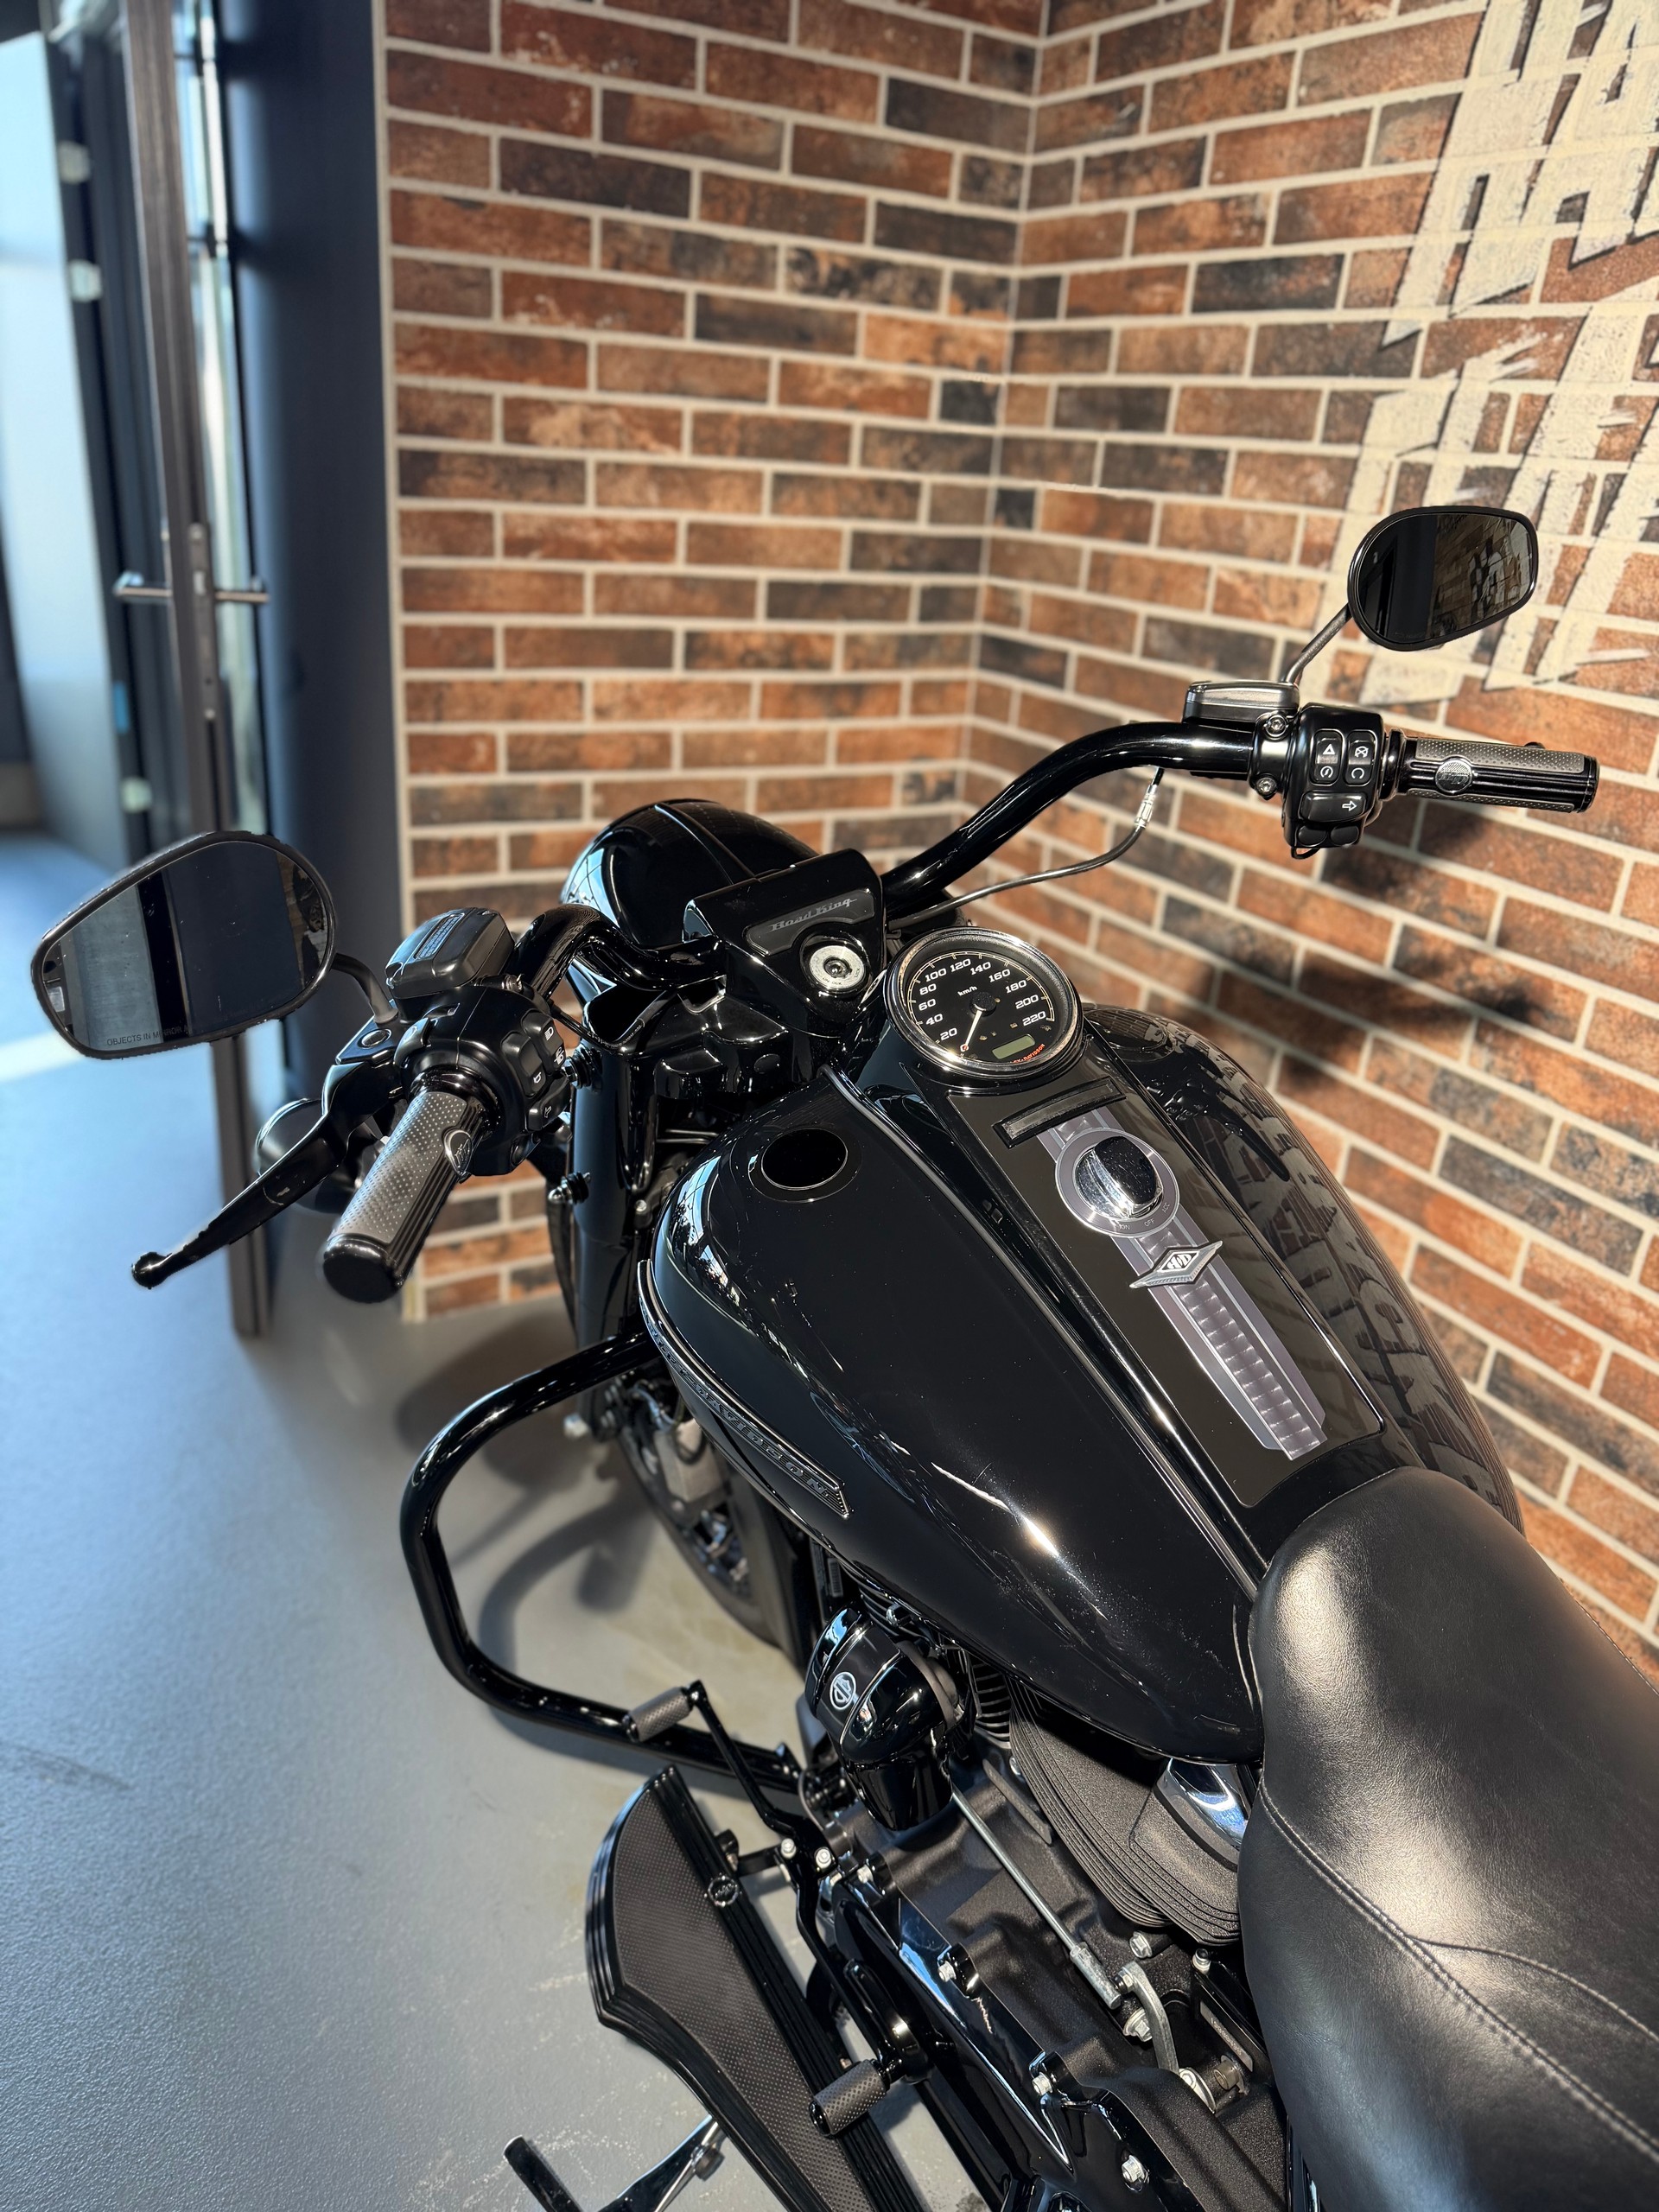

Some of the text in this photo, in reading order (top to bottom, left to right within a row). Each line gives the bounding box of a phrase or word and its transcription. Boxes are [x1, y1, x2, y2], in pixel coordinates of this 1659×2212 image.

[770, 913, 813, 932] Road
[950, 958, 971, 973] 120
[969, 961, 992, 976] 140
[925, 968, 947, 982] 100
[988, 969, 1011, 982] 160
[919, 983, 938, 995] 80
[957, 985, 978, 996] km/h
[1005, 979, 1027, 994] 180
[918, 998, 937, 1011] 60
[1015, 995, 1039, 1009] 200
[925, 1013, 944, 1026] 40
[1022, 1010, 1046, 1027] 220
[106, 1034, 142, 1046] OBJECTS
[940, 1027, 958, 1040] 20
[1144, 1217, 1155, 1227] OFF
[1161, 1202, 1170, 1213] ACC
